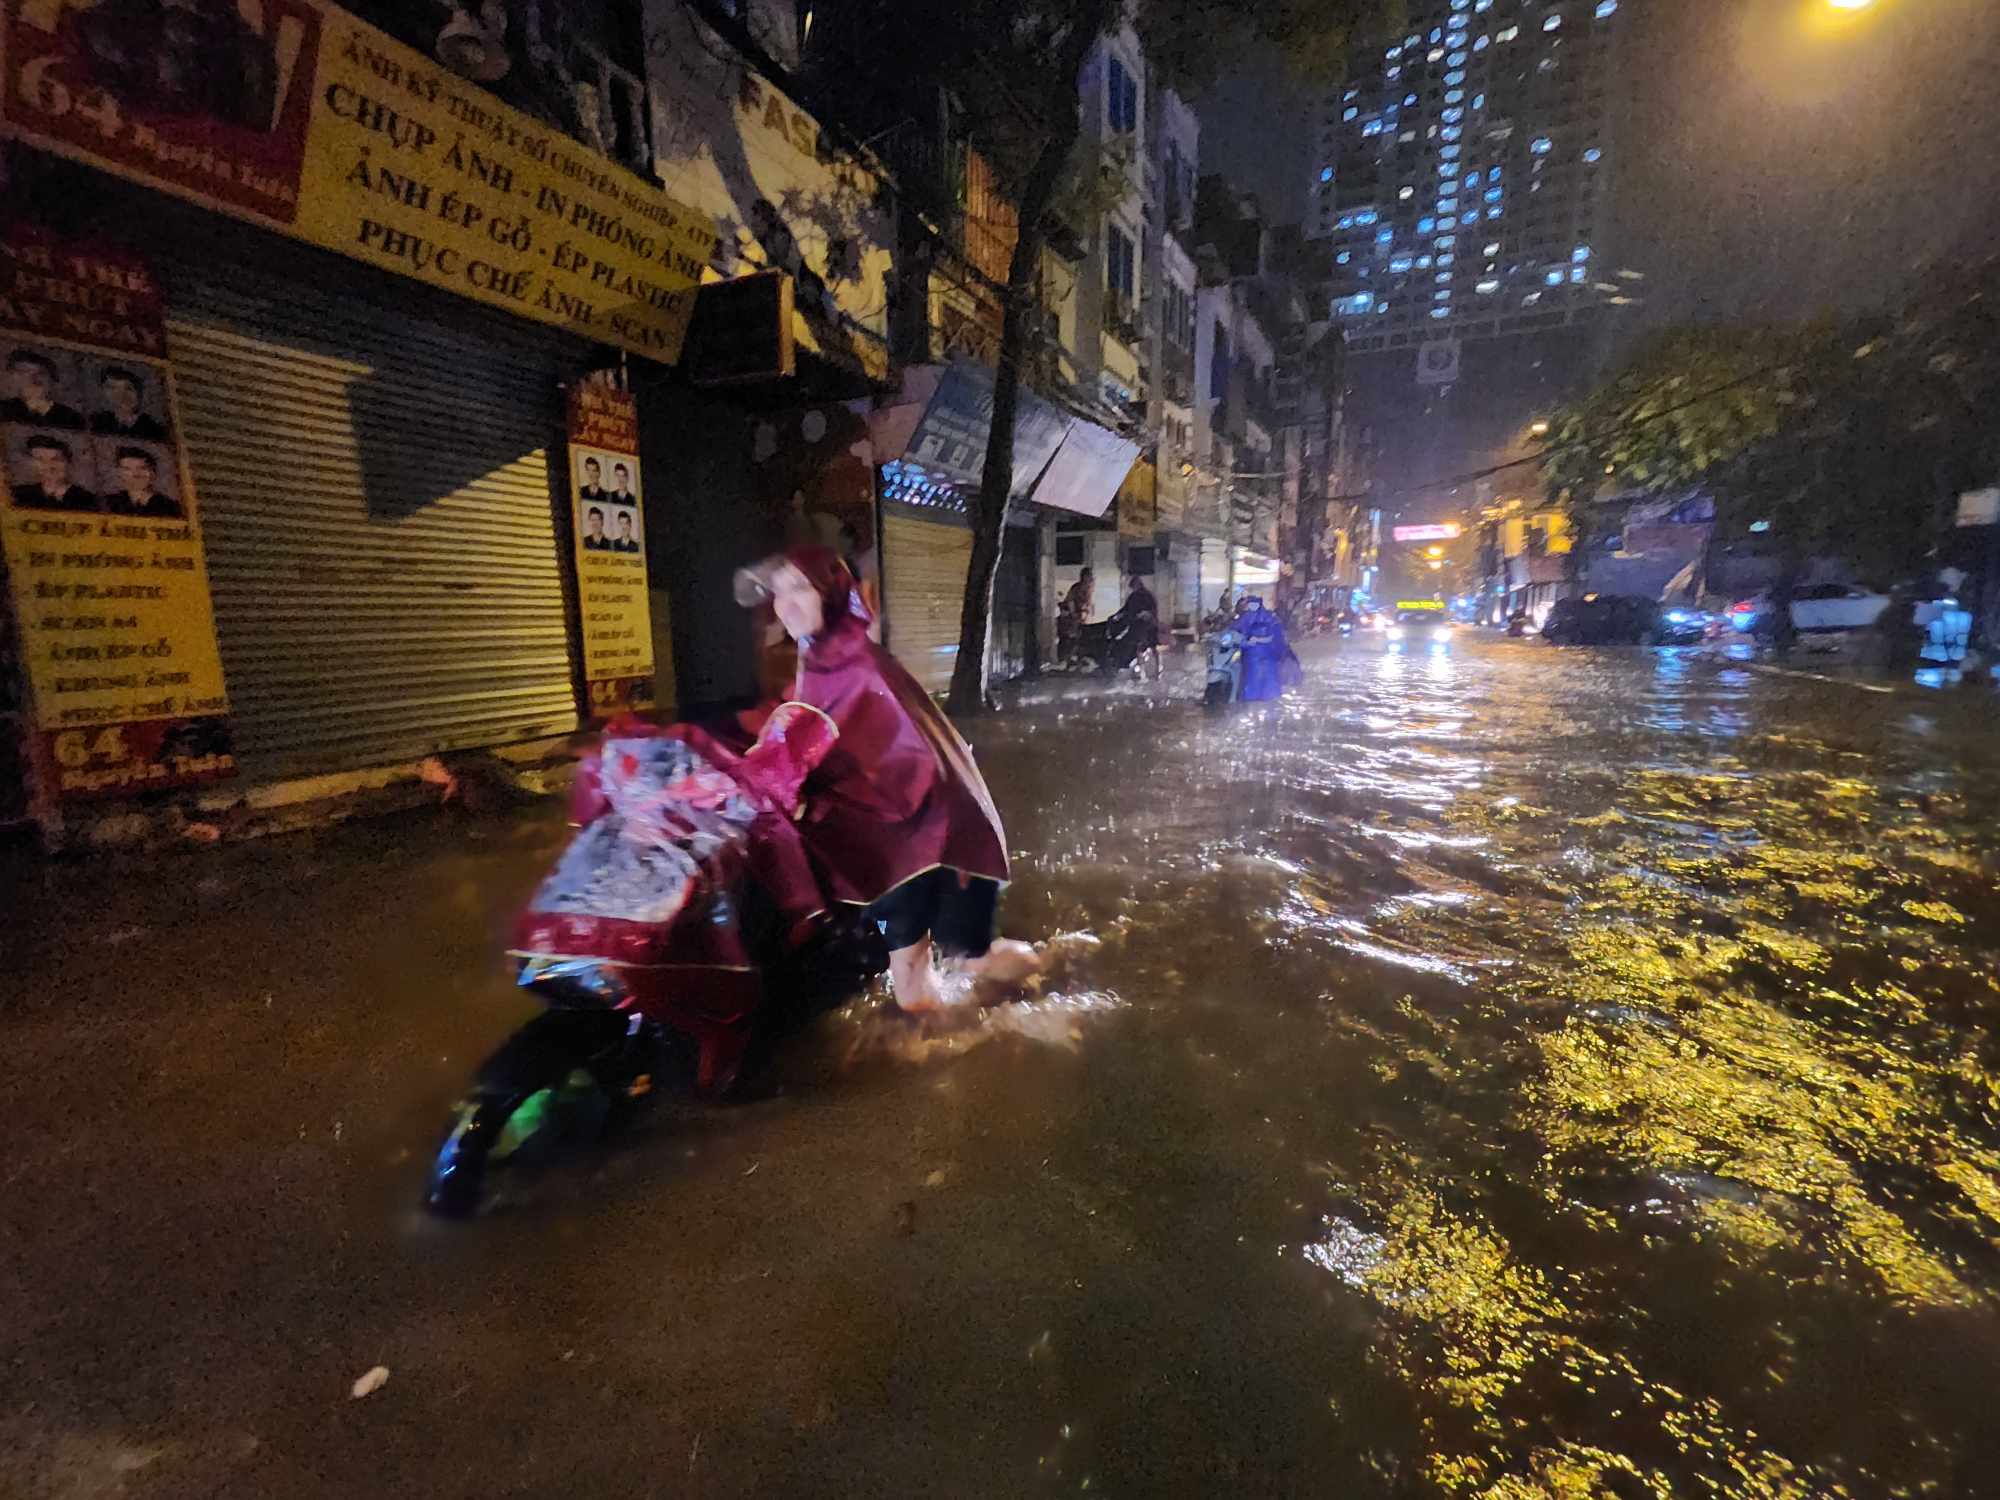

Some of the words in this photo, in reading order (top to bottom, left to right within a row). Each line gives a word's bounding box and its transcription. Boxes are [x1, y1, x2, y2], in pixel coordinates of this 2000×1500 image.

[326, 82, 435, 153] CHỤP
[443, 132, 511, 194] ẢNH
[535, 184, 568, 221] IN
[571, 200, 654, 259] PHÓNG
[658, 237, 704, 281] ẢNH
[346, 146, 432, 212] ẢNH
[440, 192, 482, 229] ÉP
[488, 216, 532, 253] GỖ
[552, 240, 588, 272] ÉP
[591, 262, 682, 313] PLASTIC
[357, 219, 461, 275] PHỤC
[466, 259, 532, 301] CHẾ
[536, 280, 593, 326] ẢNH
[609, 314, 673, 349] SCAN
